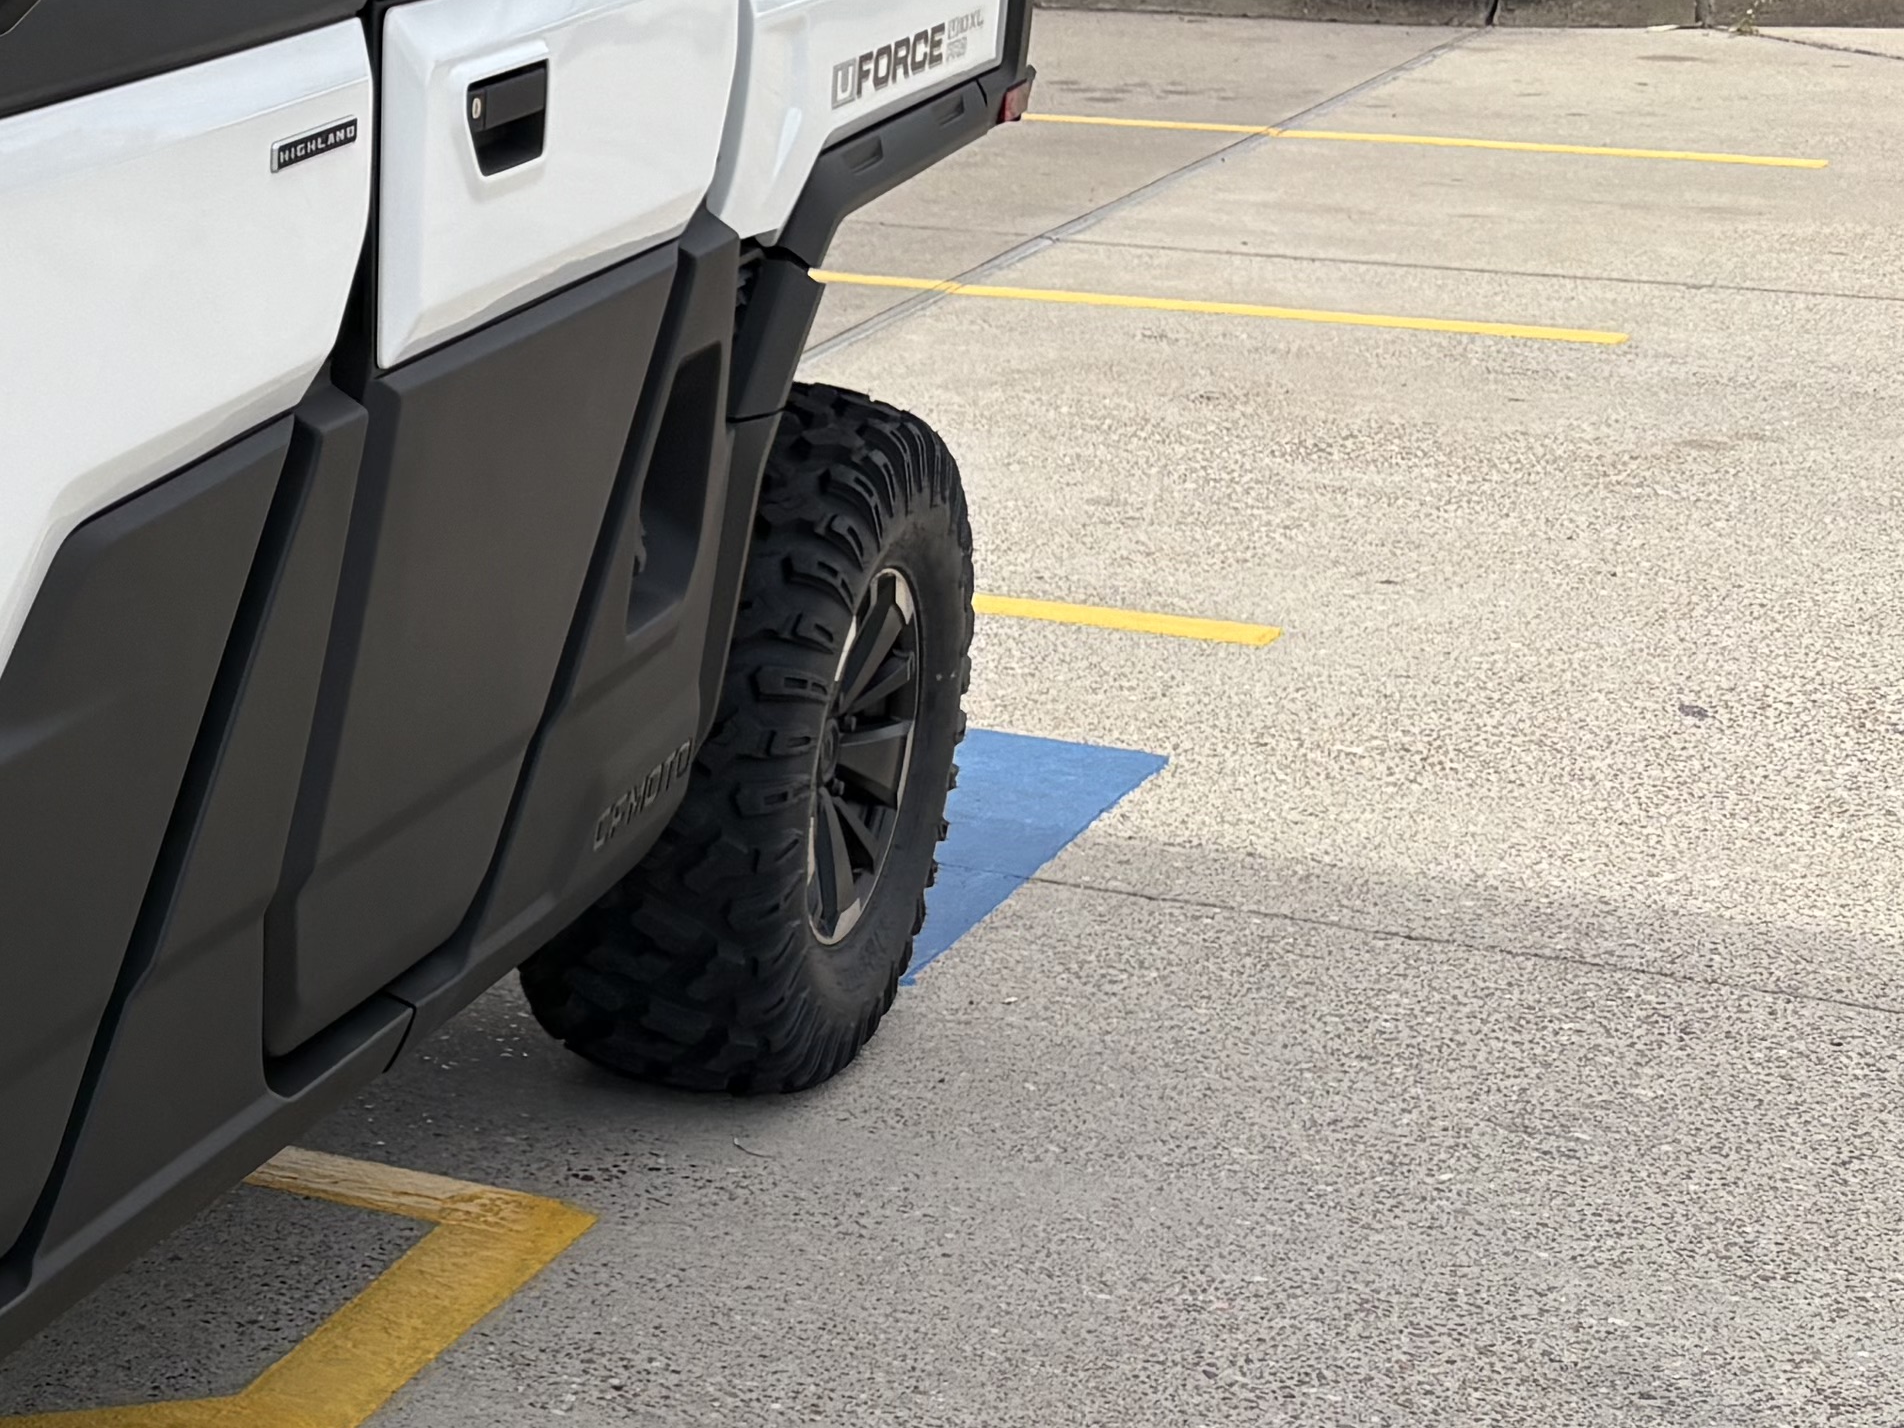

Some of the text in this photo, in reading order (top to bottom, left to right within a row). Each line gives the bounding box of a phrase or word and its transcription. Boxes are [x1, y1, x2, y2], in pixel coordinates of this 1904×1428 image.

[830, 21, 946, 111] UFORCE
[279, 125, 355, 163] HIGHLAND
[592, 737, 691, 852] CFMOTO
